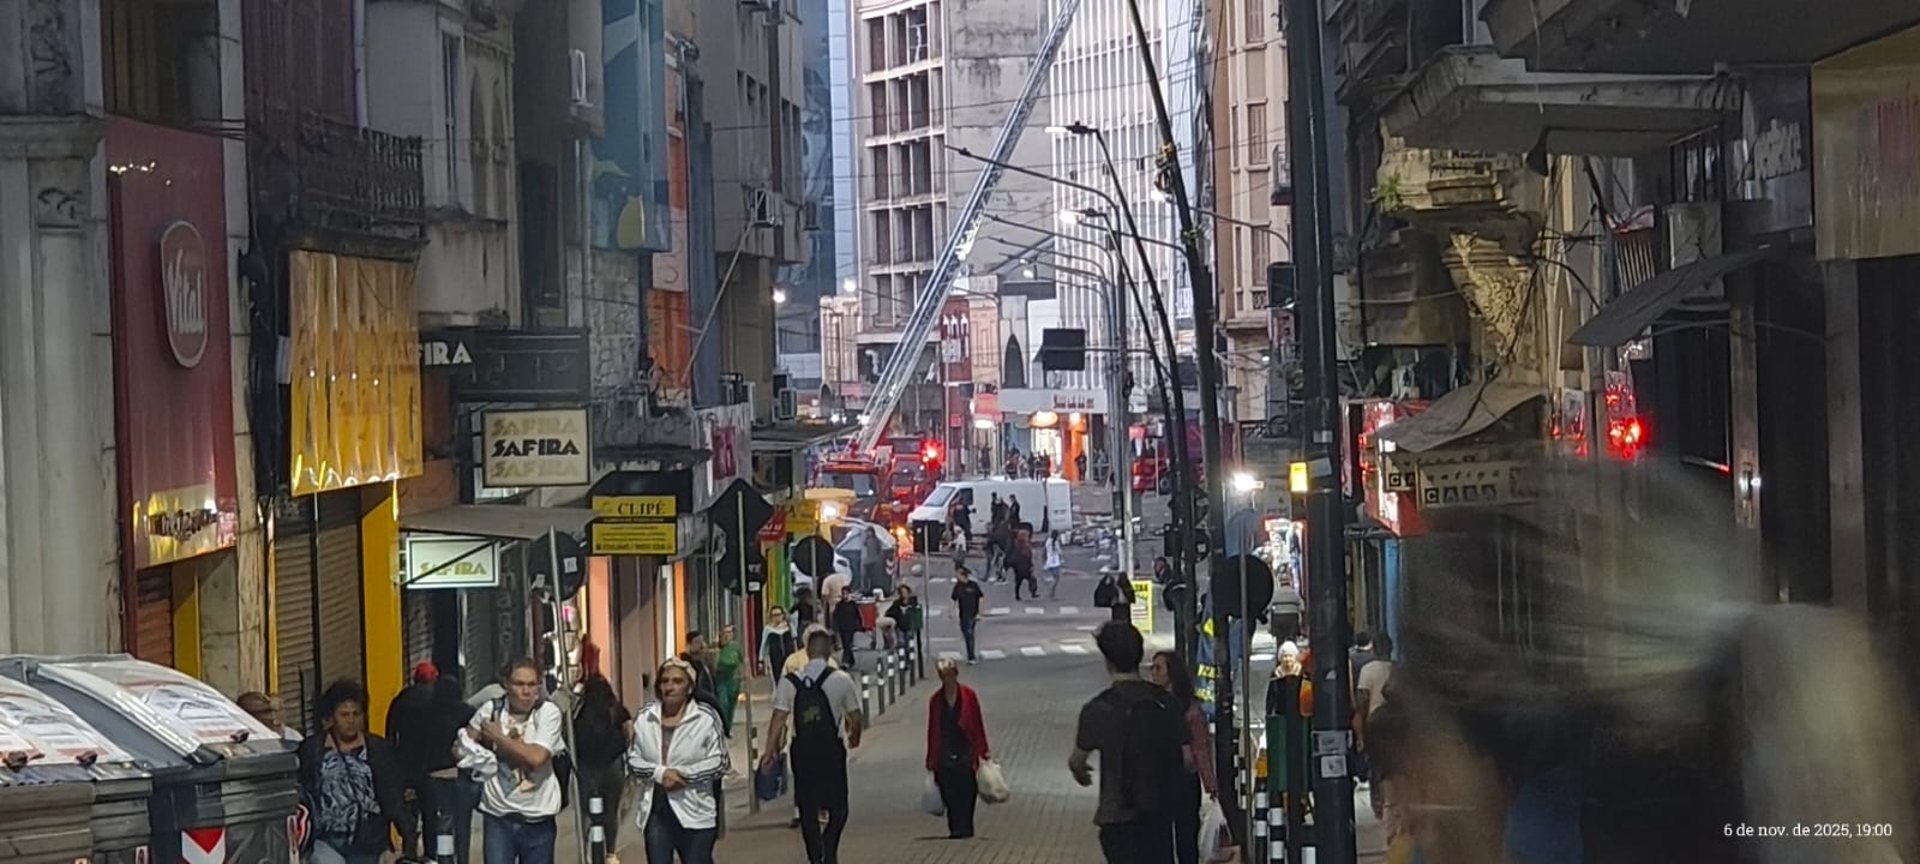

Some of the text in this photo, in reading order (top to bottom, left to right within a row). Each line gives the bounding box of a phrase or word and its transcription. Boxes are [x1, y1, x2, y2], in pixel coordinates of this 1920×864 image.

[167, 248, 204, 335] Vital
[491, 416, 577, 435] SAFIRA
[491, 438, 579, 457] SAFIRA
[617, 499, 666, 515] CLIPÉ
